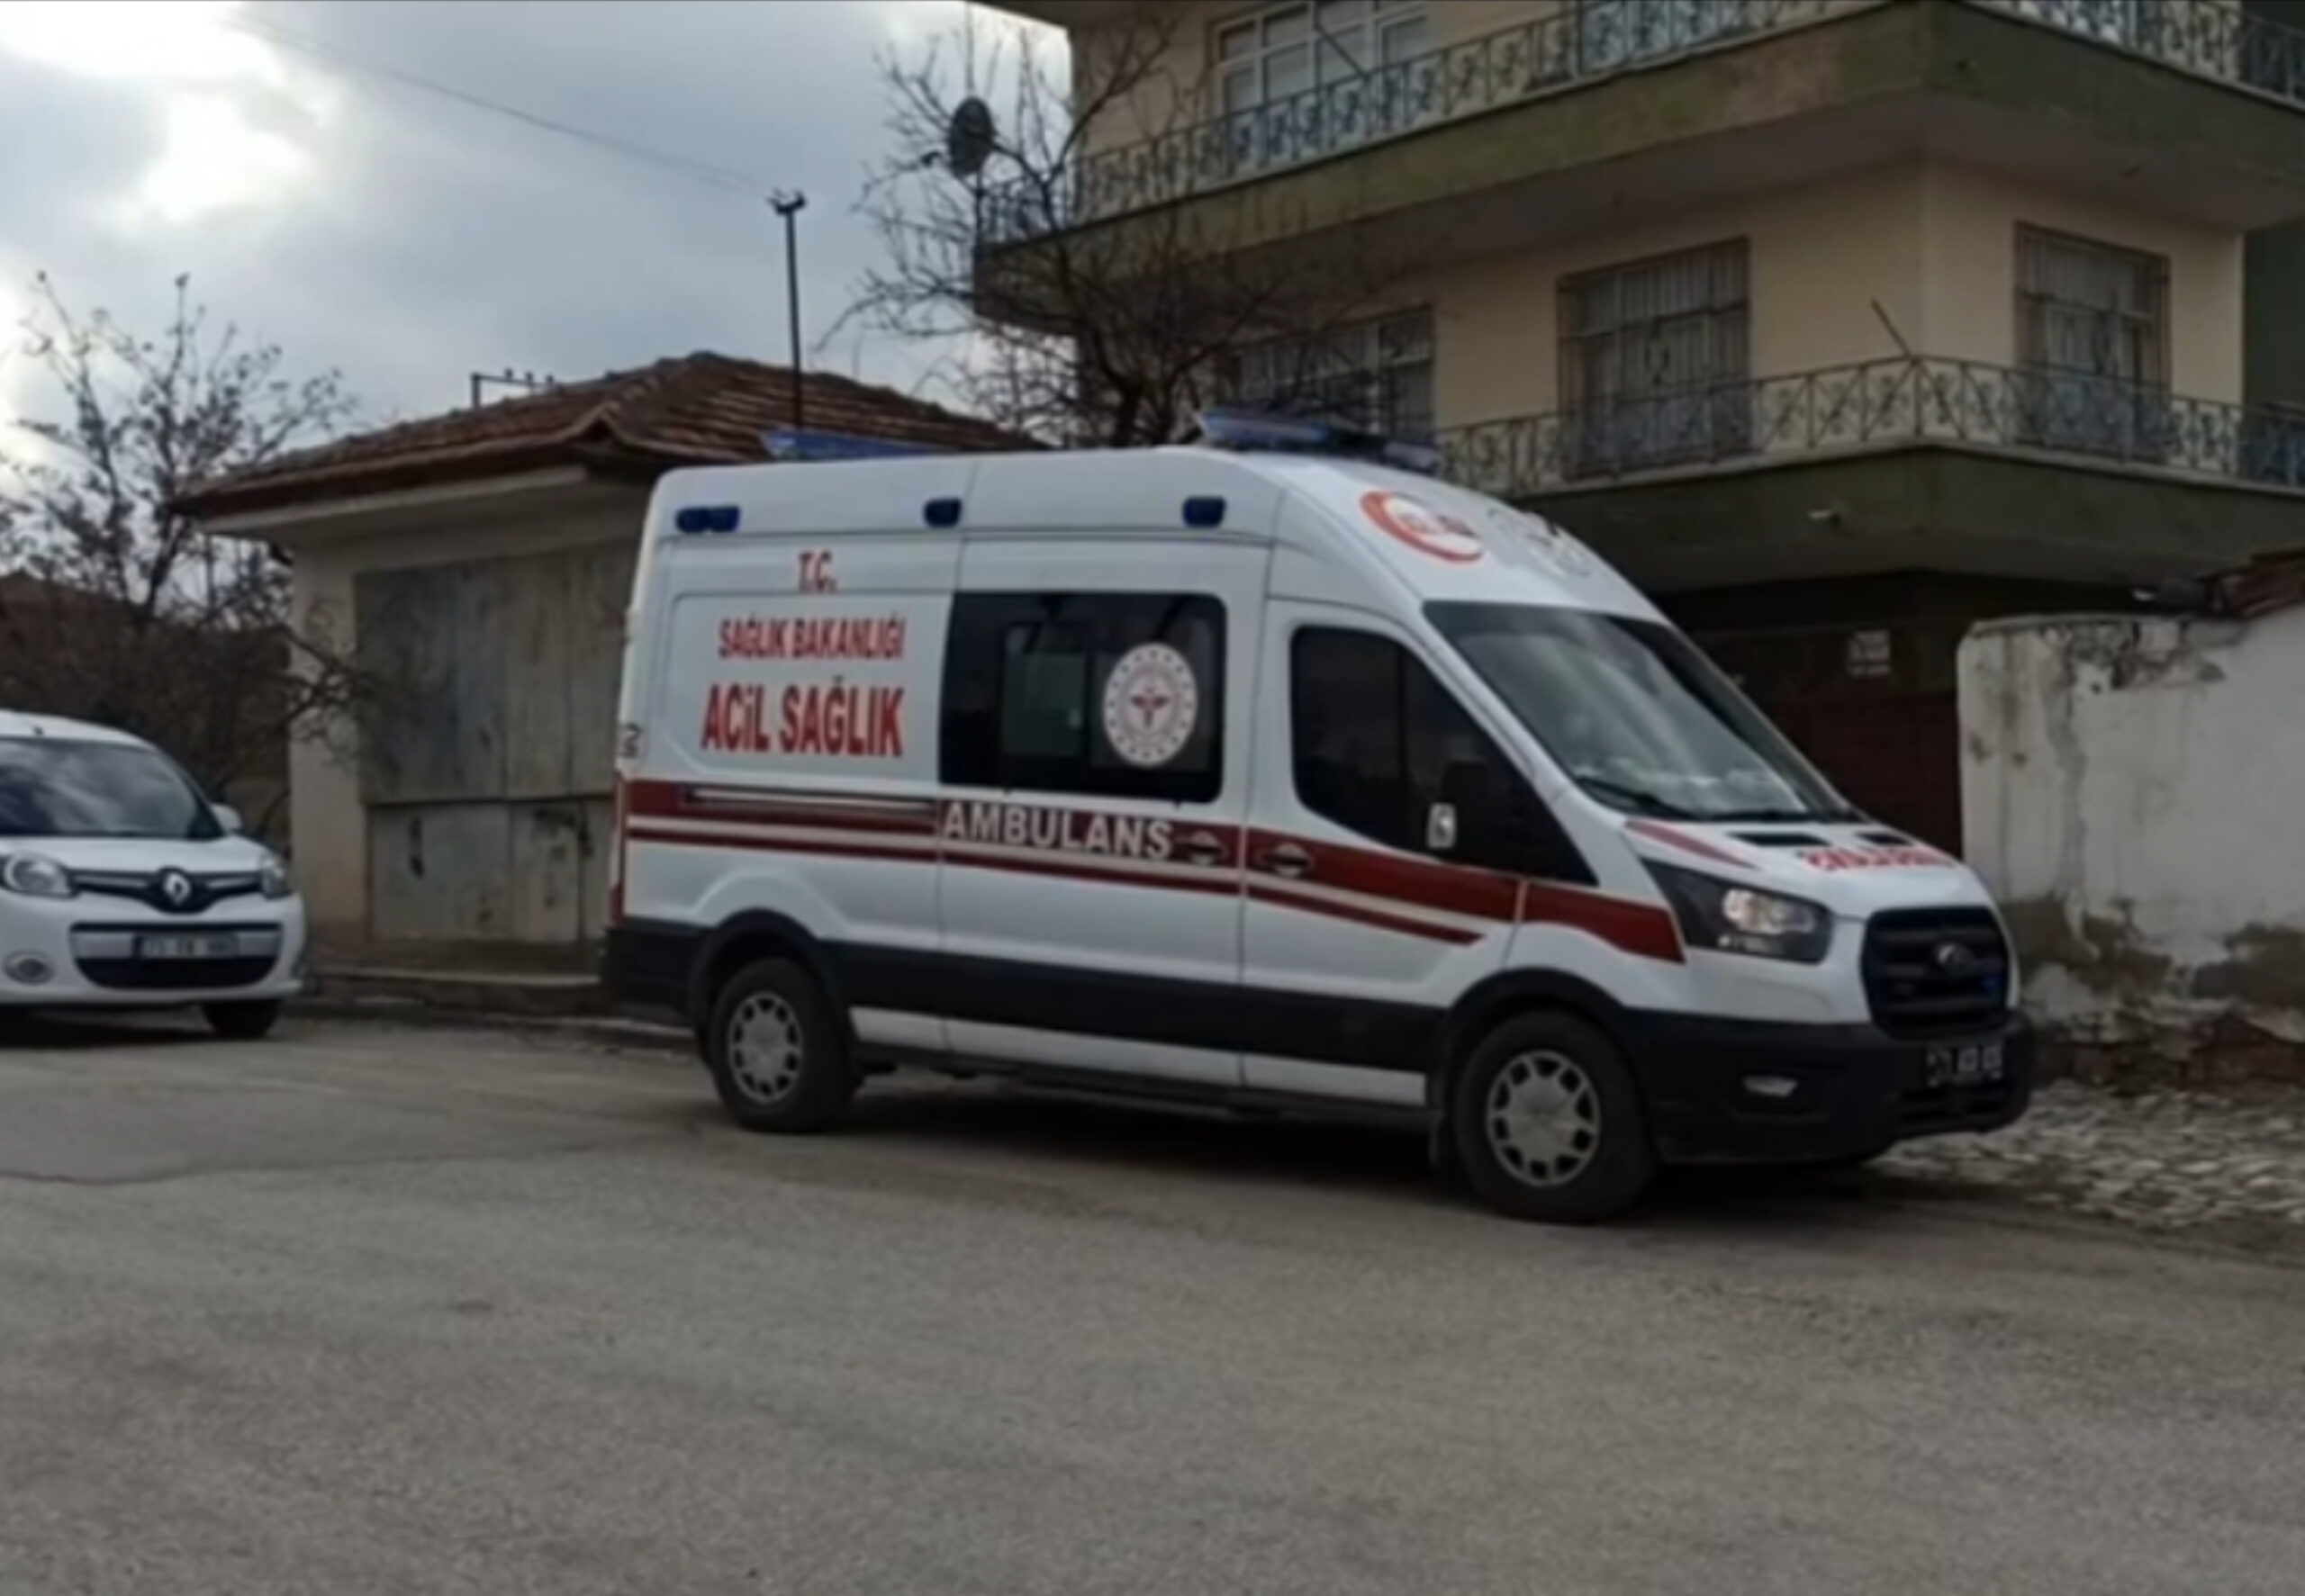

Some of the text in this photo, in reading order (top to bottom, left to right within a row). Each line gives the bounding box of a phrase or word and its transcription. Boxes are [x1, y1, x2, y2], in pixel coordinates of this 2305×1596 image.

[719, 612, 906, 660] SAĞLIK BAKANLIĞI
[779, 675, 904, 758] SAĞLIK
[945, 800, 1171, 860] AMBULANS
